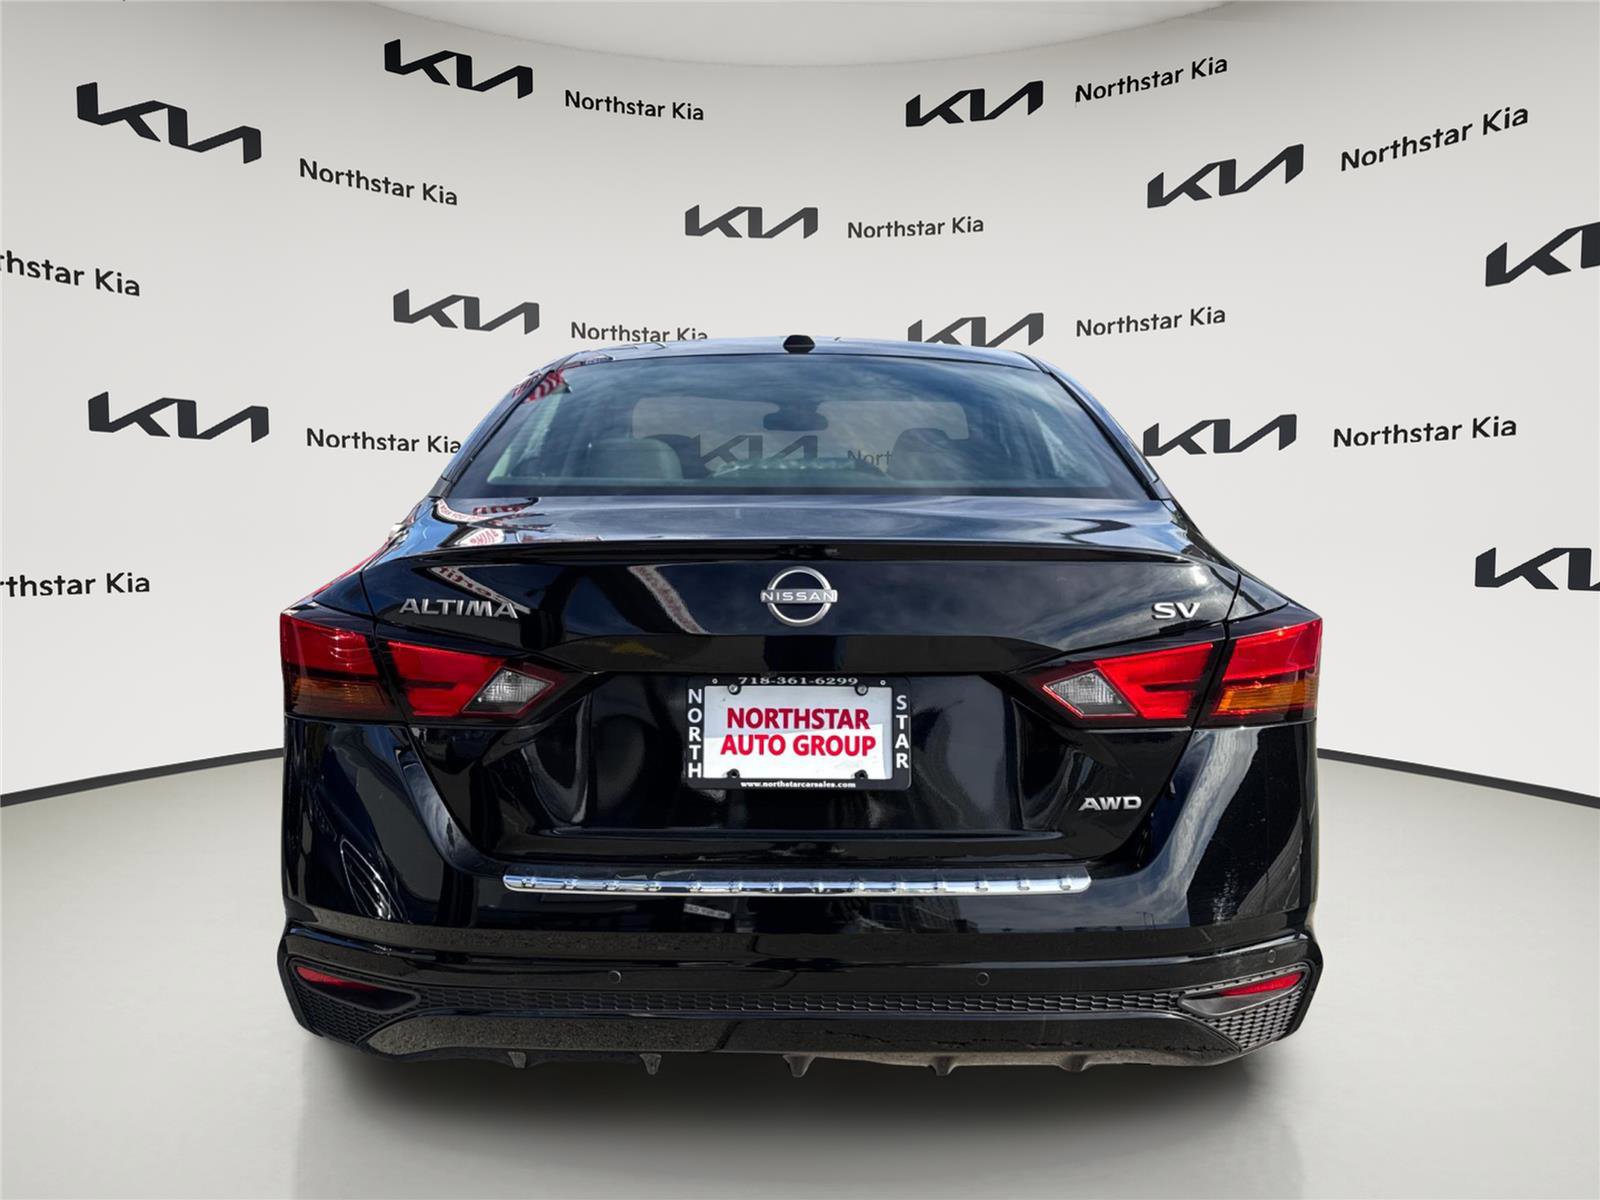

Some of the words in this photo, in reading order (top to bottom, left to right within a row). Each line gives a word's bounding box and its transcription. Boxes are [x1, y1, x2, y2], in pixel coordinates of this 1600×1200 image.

[384, 39, 533, 100] KIA
[565, 90, 666, 118] Northstar
[672, 102, 704, 121] Kia
[906, 80, 1044, 127] KIA
[1075, 66, 1184, 103] Northstar
[1191, 57, 1228, 79] Kia
[76, 82, 261, 164] KIA
[299, 158, 416, 198] Northstar
[422, 182, 458, 206] Kia
[1147, 144, 1304, 208] KIA
[1341, 121, 1474, 171] Northstar
[1482, 104, 1529, 136] Kia
[685, 205, 818, 239] KIA
[847, 220, 946, 239] Northstar
[952, 215, 985, 234] Kia
[95, 268, 140, 296] Kia
[393, 289, 539, 334] KIA
[571, 321, 671, 342] Northstar
[1076, 313, 1183, 337] Northstar
[1190, 306, 1226, 327] Kia
[88, 392, 269, 443] KIA
[306, 427, 420, 452] Northstar
[427, 435, 461, 454] Kia
[1143, 414, 1297, 456] KIA
[1333, 420, 1463, 448] Northstar
[1472, 415, 1517, 439] Kia
[106, 572, 150, 594] Kia
[761, 591, 835, 602] NISSAN
[399, 597, 519, 619] ALTIMA
[1152, 602, 1200, 619] SV
[738, 676, 859, 686] 718-361-6299
[687, 688, 703, 779] NORTH
[726, 707, 871, 730] NORTHSTAR
[895, 695, 910, 769] STAR
[720, 734, 787, 756] AUTO
[792, 735, 877, 757] GROUP
[740, 780, 857, 789] www.northstarcarsales.com
[1079, 795, 1142, 811] AWD
